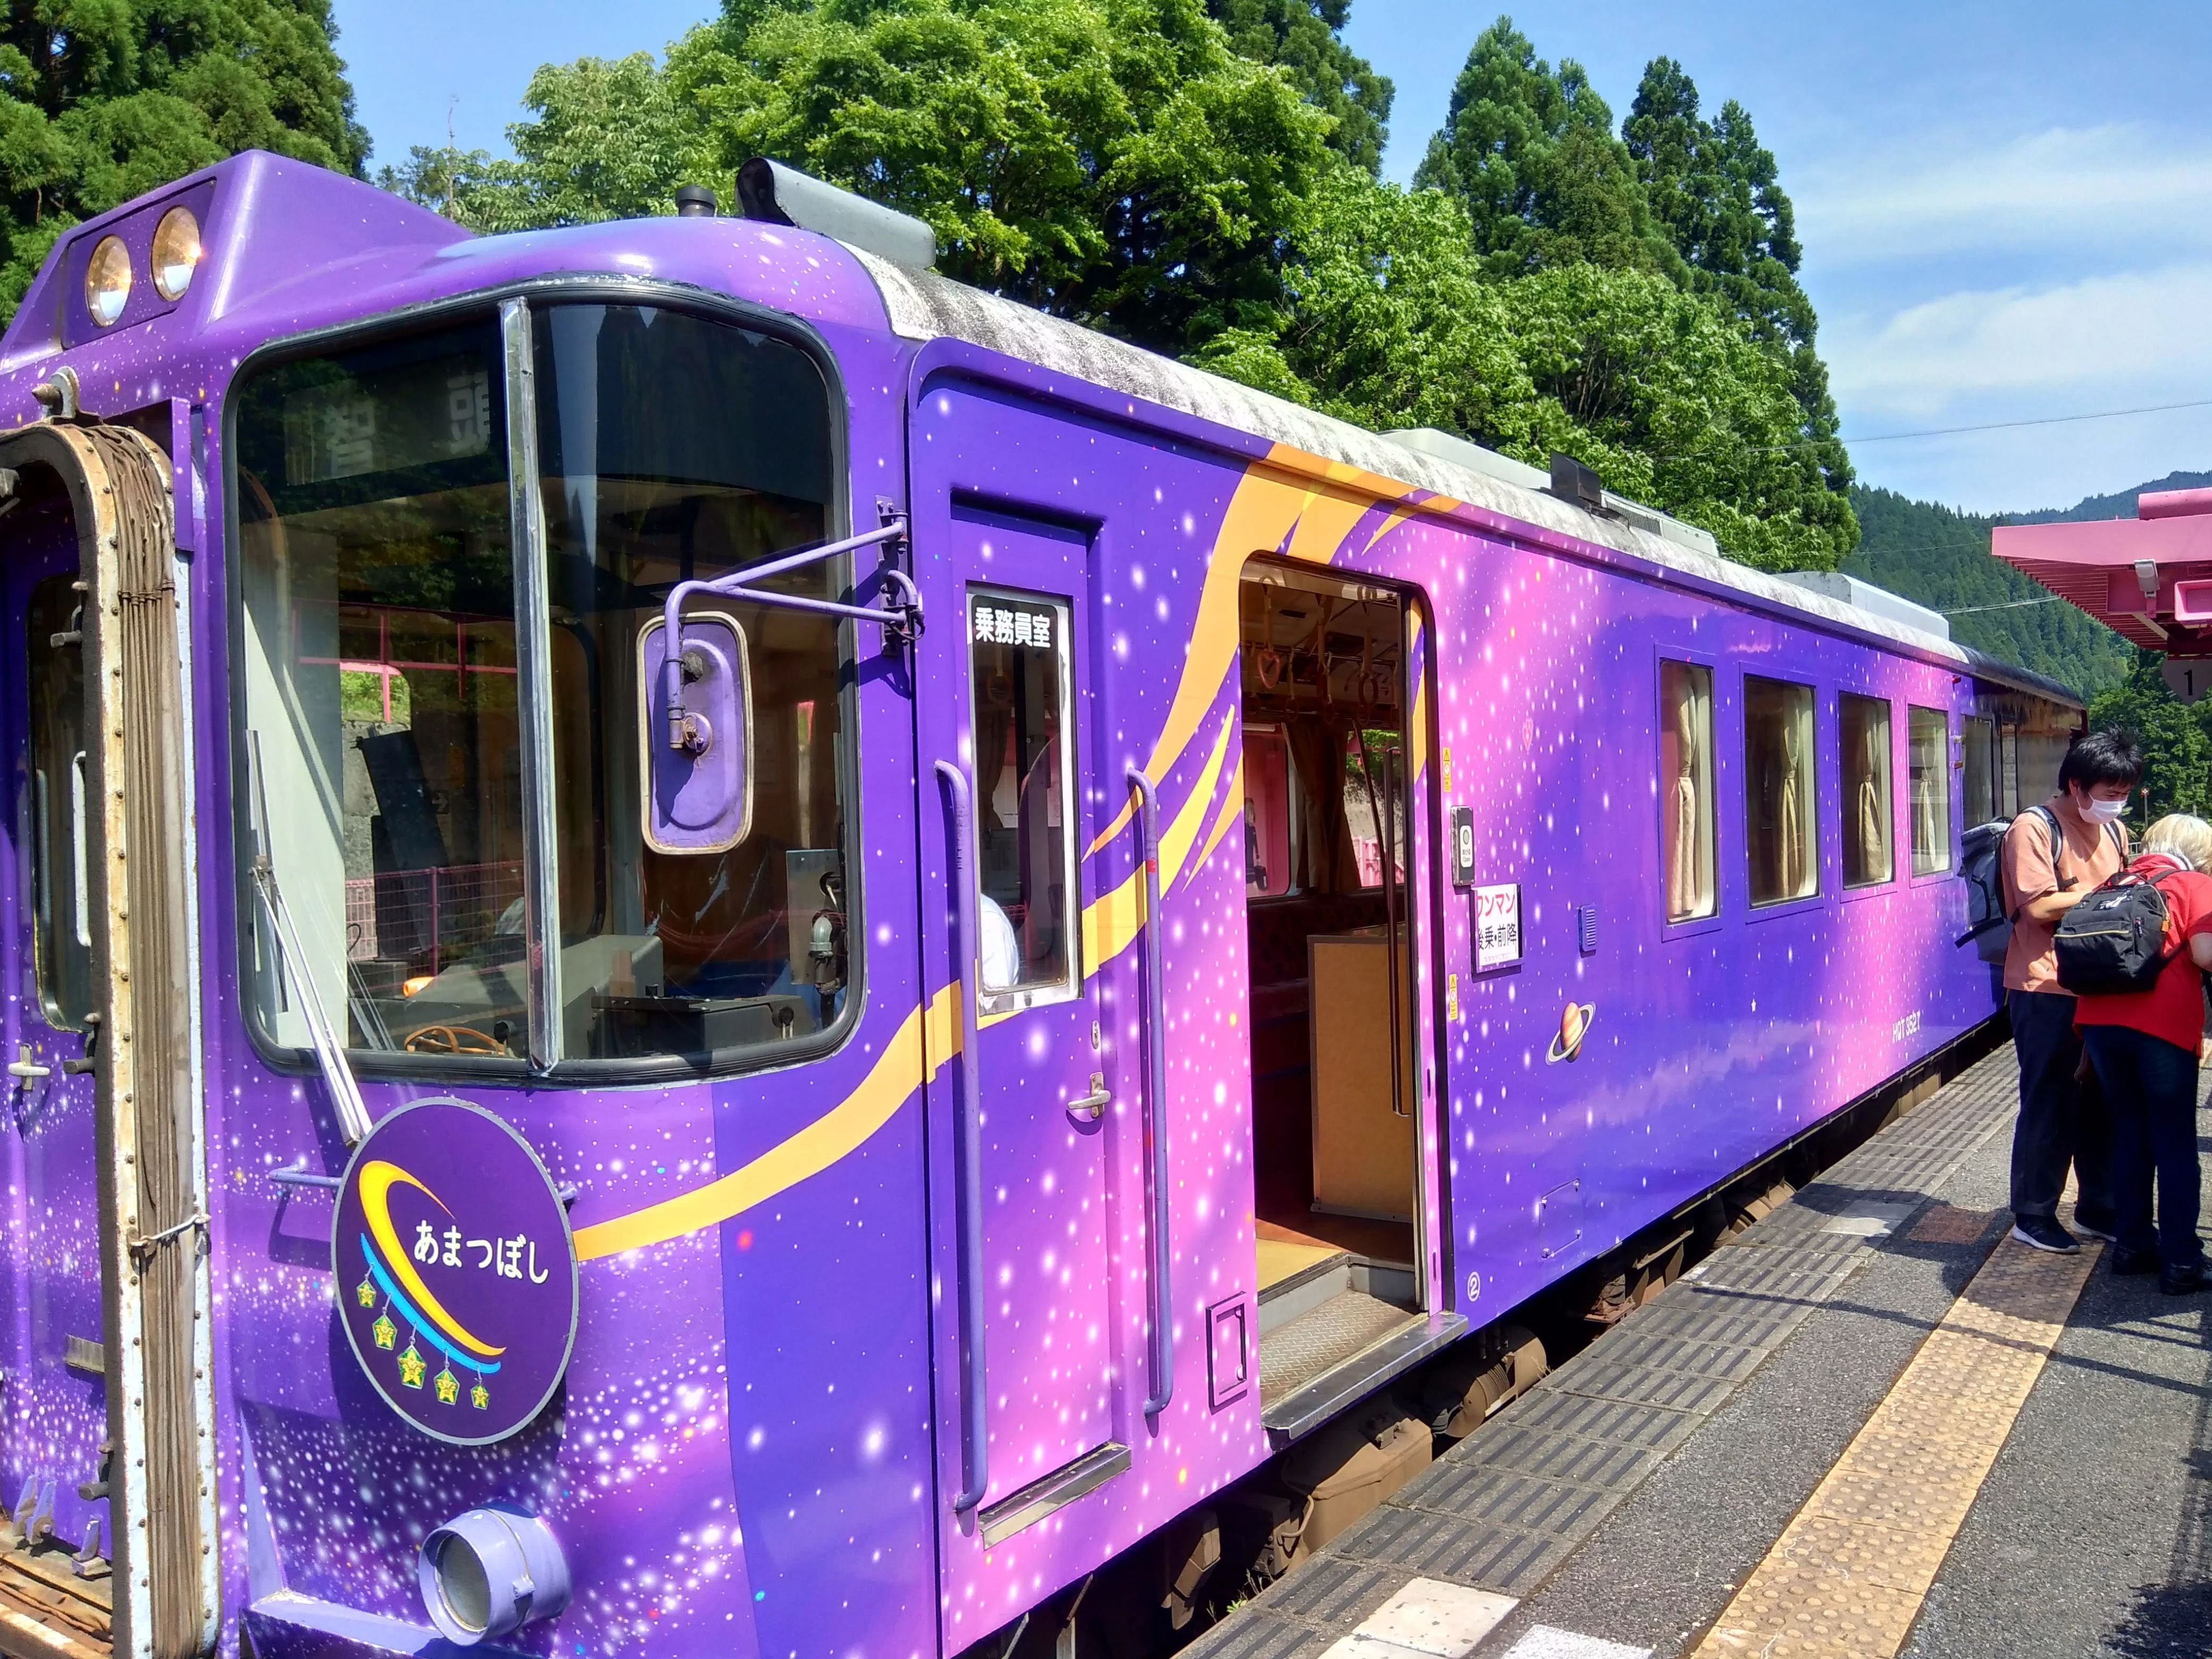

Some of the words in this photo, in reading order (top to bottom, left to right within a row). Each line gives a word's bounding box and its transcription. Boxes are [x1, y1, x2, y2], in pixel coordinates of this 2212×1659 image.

[975, 607, 1051, 648] 乗務員室
[2184, 669, 2193, 696] 1
[1892, 1018, 1905, 1044] HOT
[413, 1219, 549, 1284] あまつぼし
